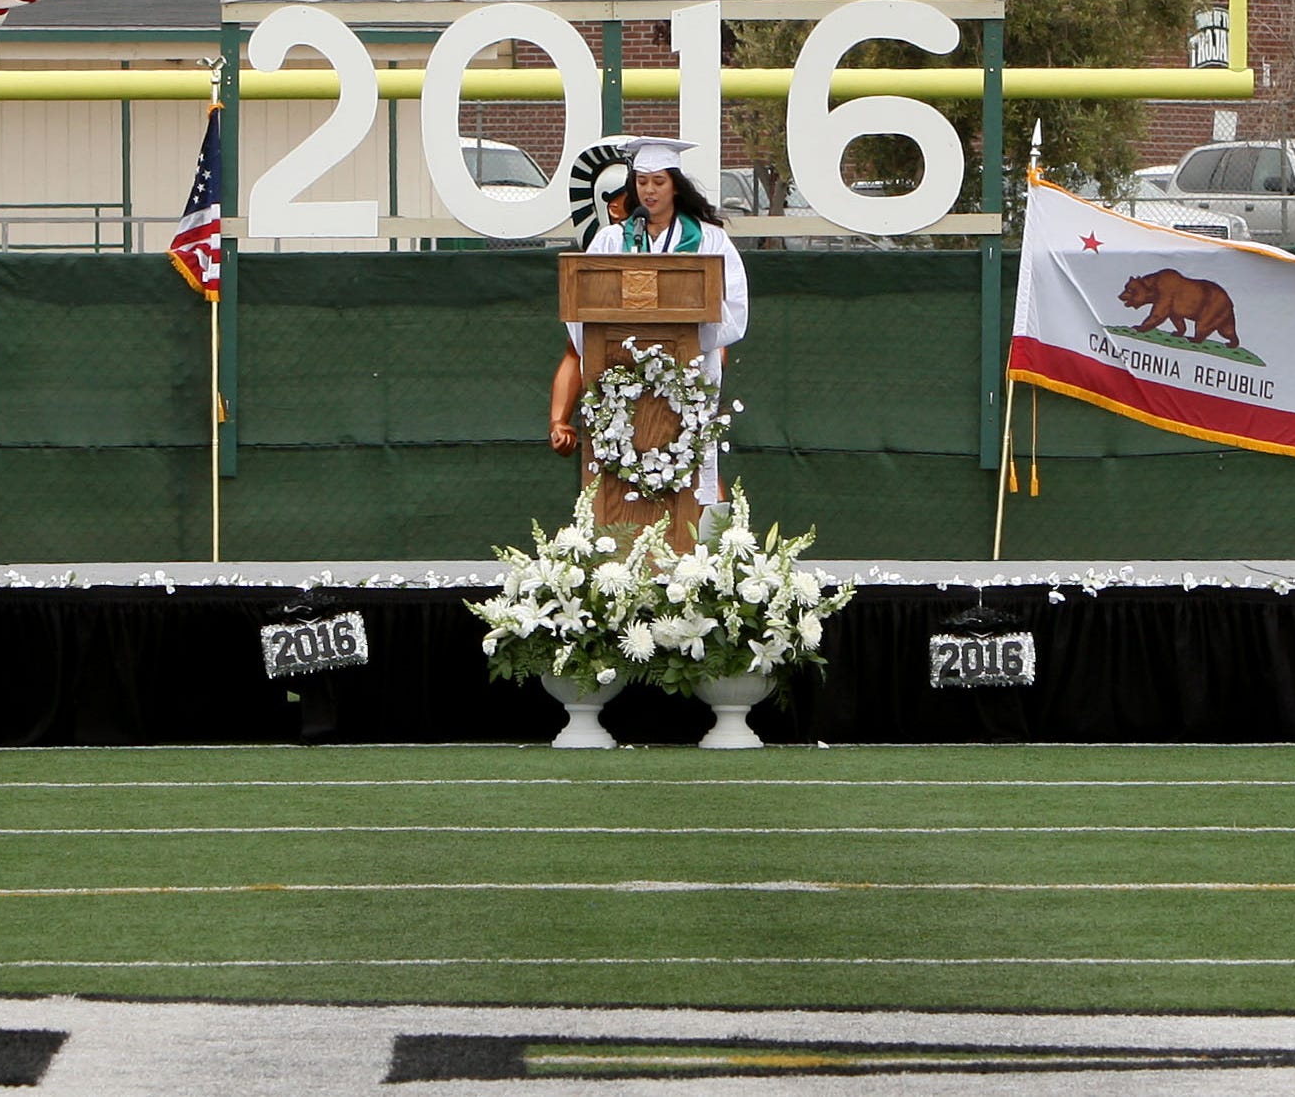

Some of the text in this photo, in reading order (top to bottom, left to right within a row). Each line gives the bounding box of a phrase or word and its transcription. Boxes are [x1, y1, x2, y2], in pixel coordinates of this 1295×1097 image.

[1189, 29, 1229, 67] TROJA
[247, 0, 965, 238] 2016
[1089, 333, 1275, 400] CALFORNIA REPUBLIC
[271, 621, 357, 666] 2016
[938, 641, 1024, 679] 2016
